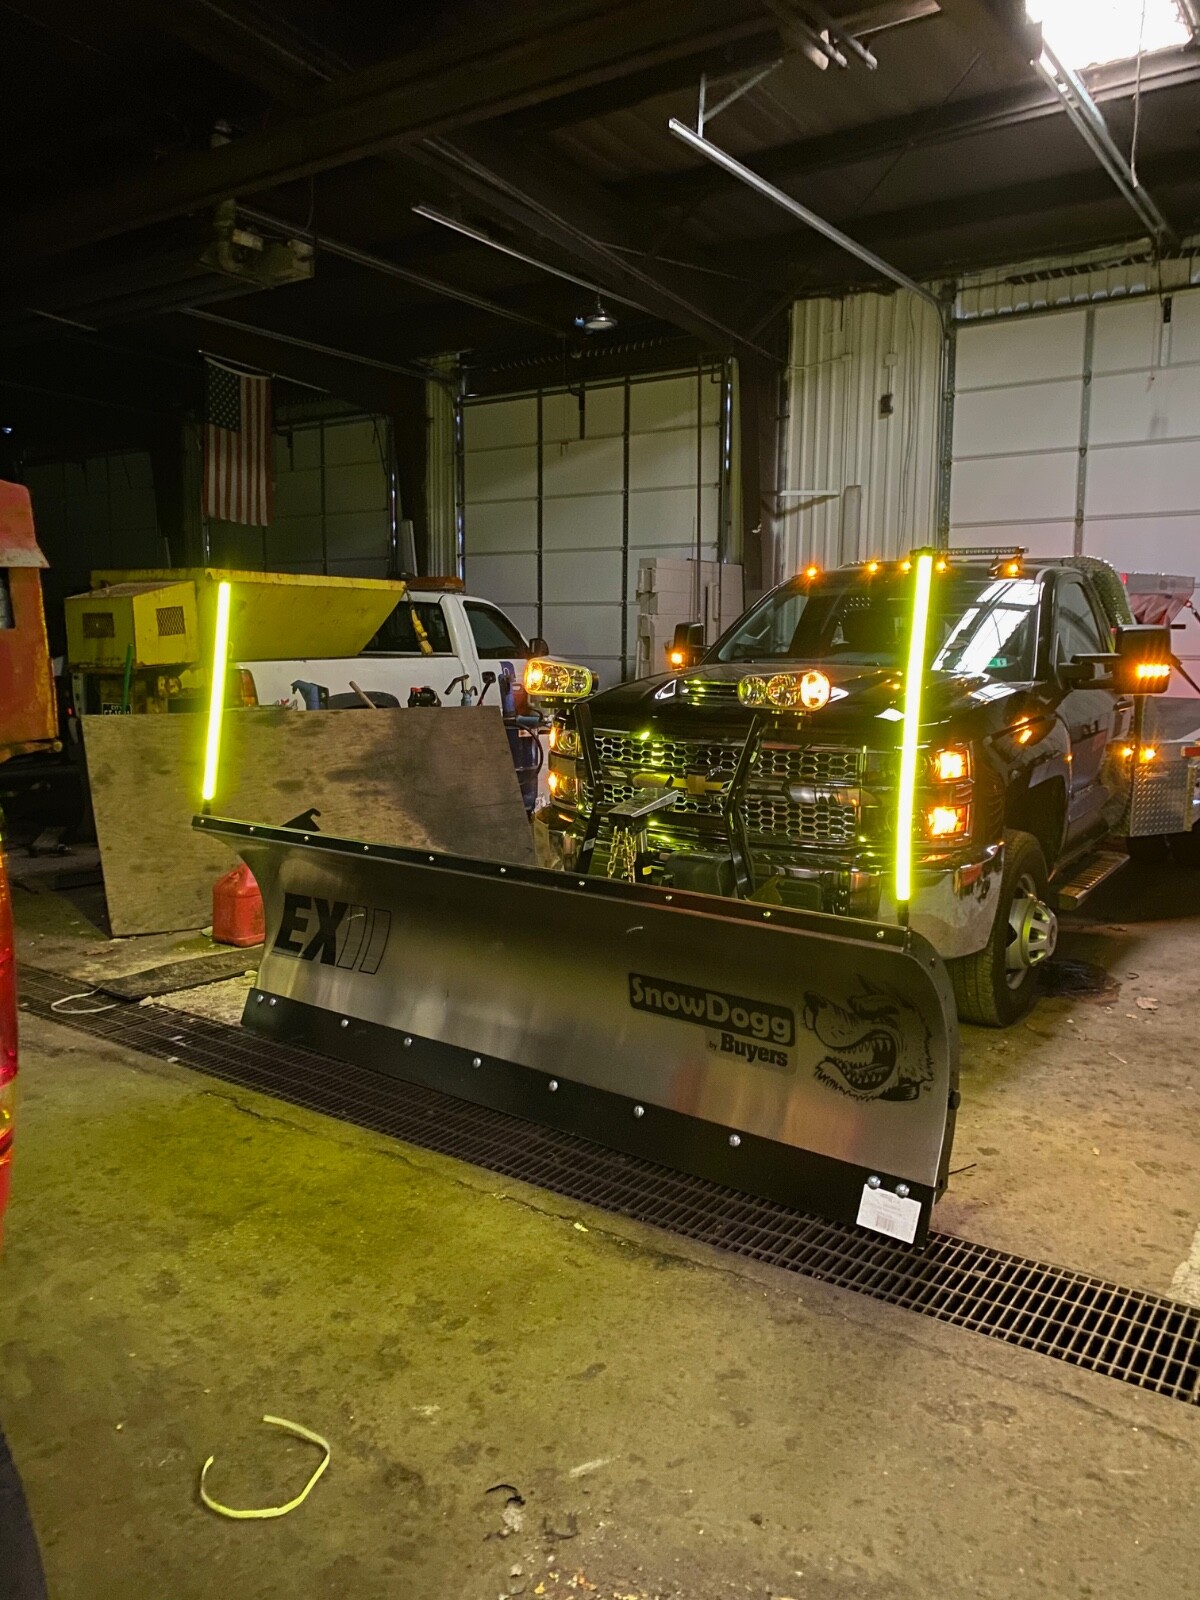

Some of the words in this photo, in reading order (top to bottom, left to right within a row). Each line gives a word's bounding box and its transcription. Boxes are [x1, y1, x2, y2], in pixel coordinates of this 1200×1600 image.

[632, 976, 792, 1044] SnowDogg
[708, 1040, 718, 1051] by
[720, 1032, 788, 1067] Buyers
